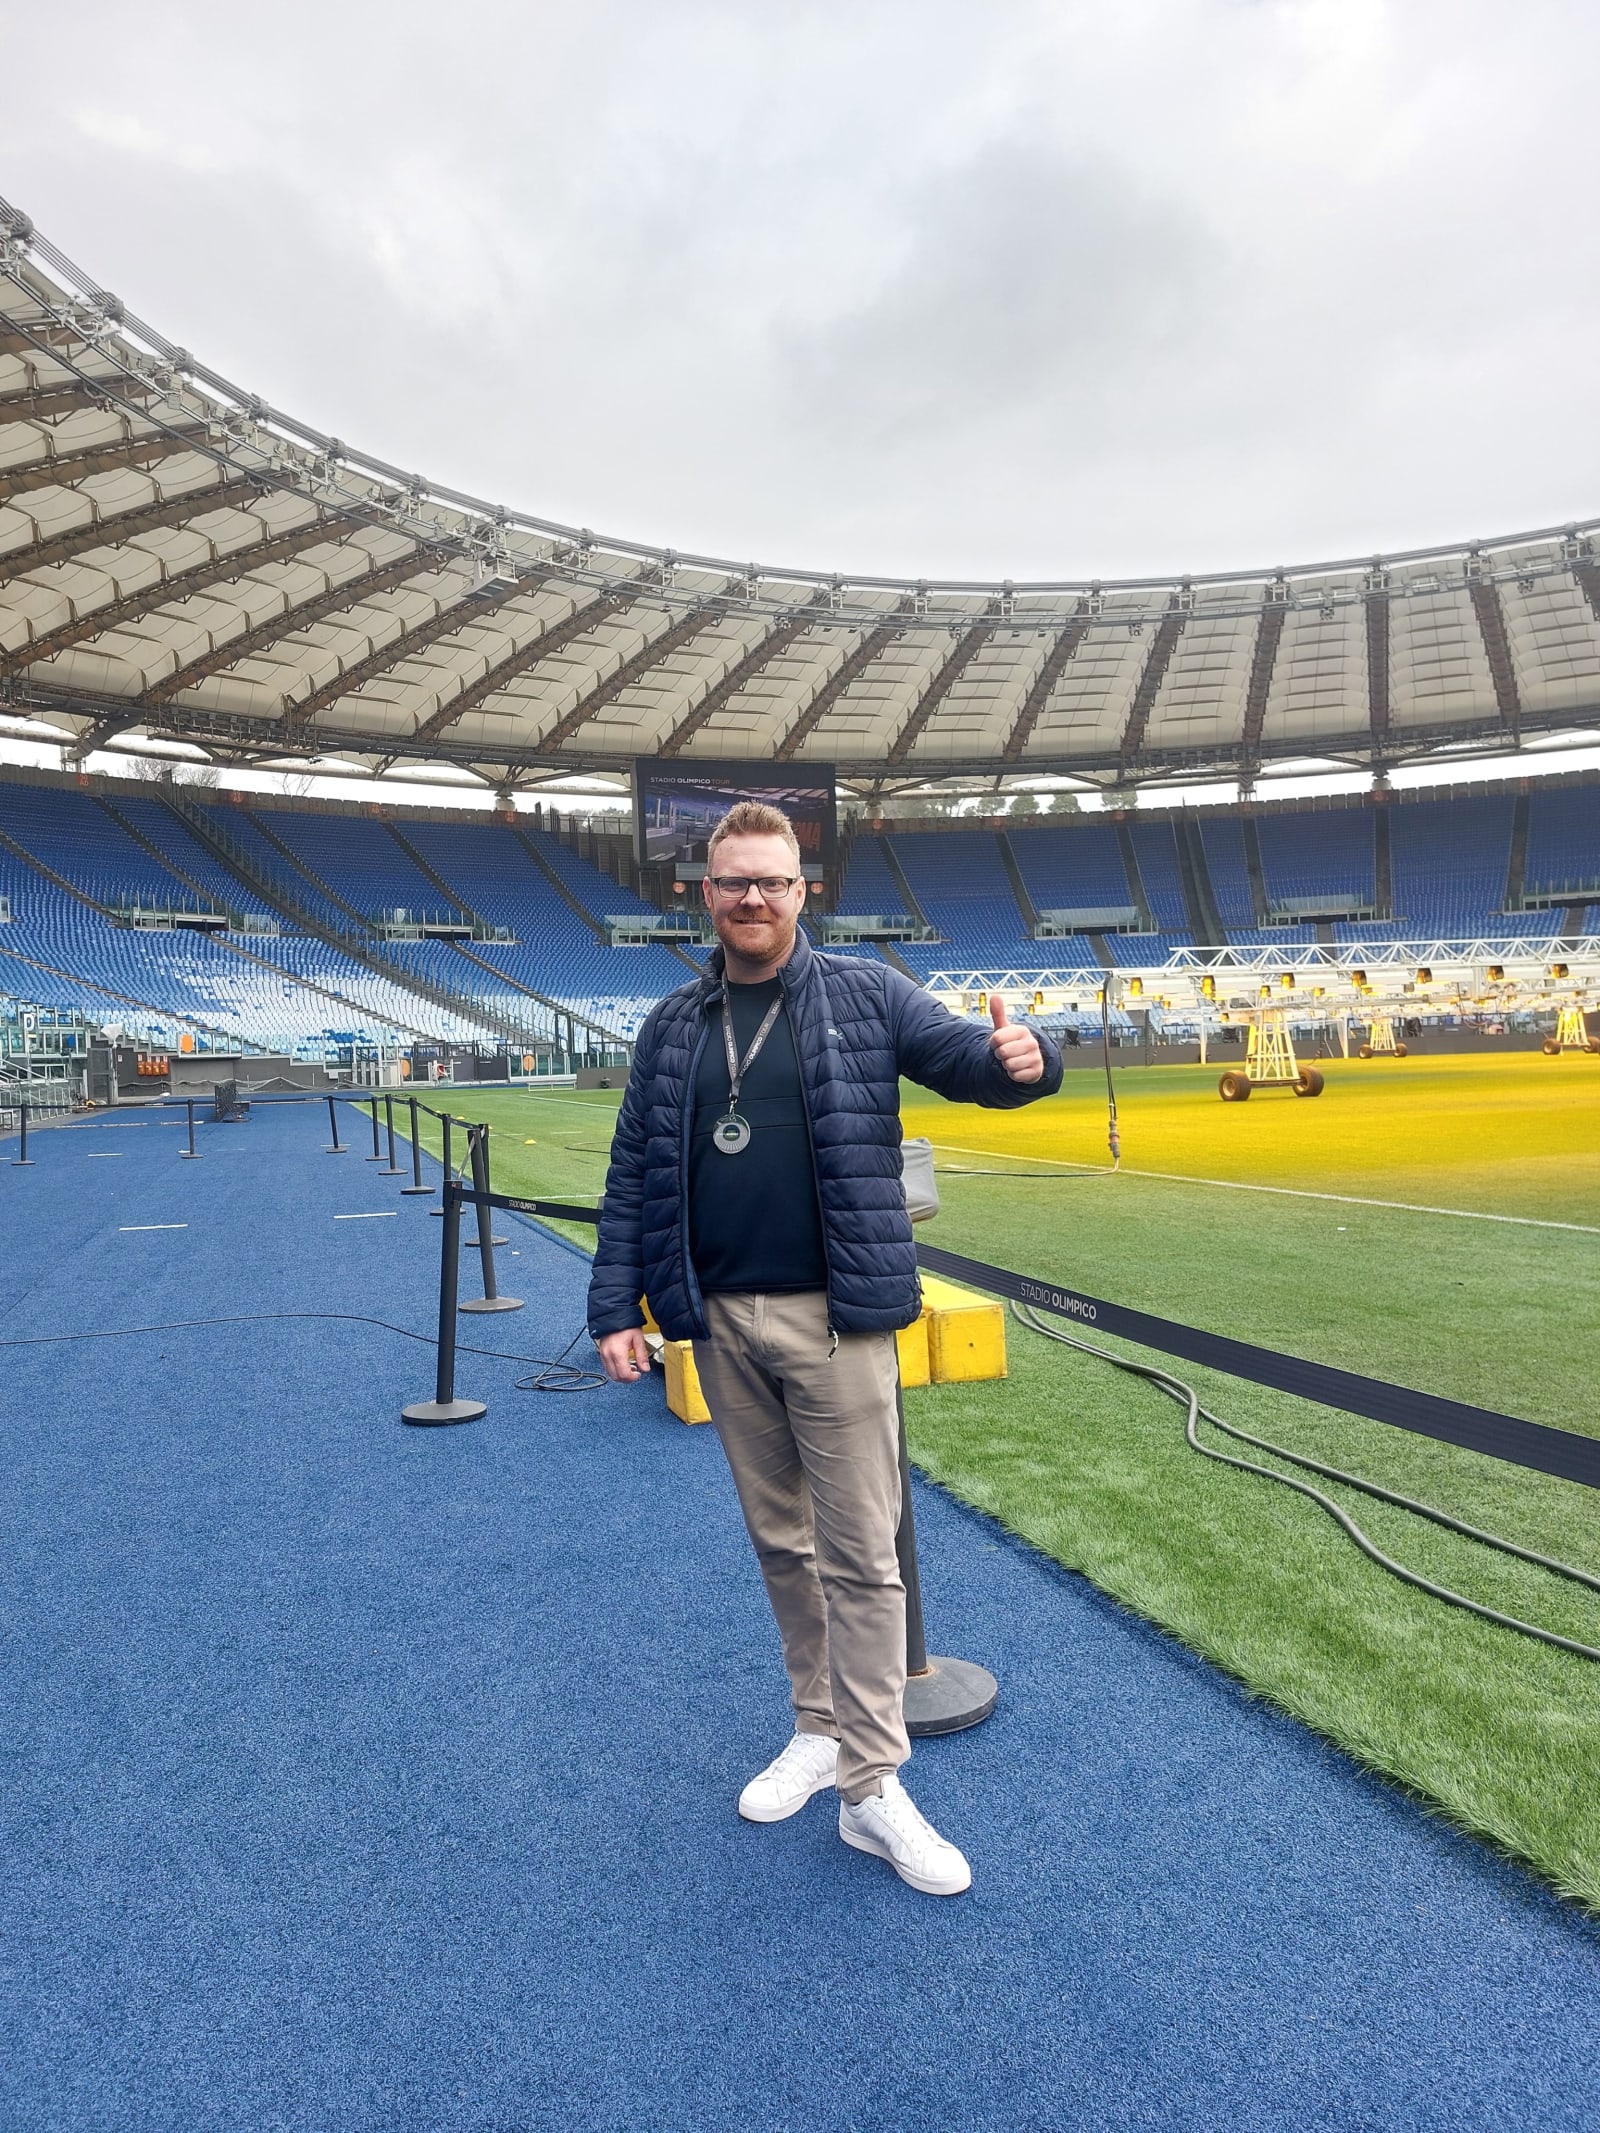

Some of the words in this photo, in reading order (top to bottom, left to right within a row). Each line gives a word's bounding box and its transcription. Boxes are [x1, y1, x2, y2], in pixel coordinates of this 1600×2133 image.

[650, 776, 676, 784] STADIO
[676, 777, 711, 785] OLIMPICO
[794, 821, 821, 851] MA
[1020, 1282, 1051, 1304] STADIO
[1051, 1292, 1097, 1320] OLIMPICO
